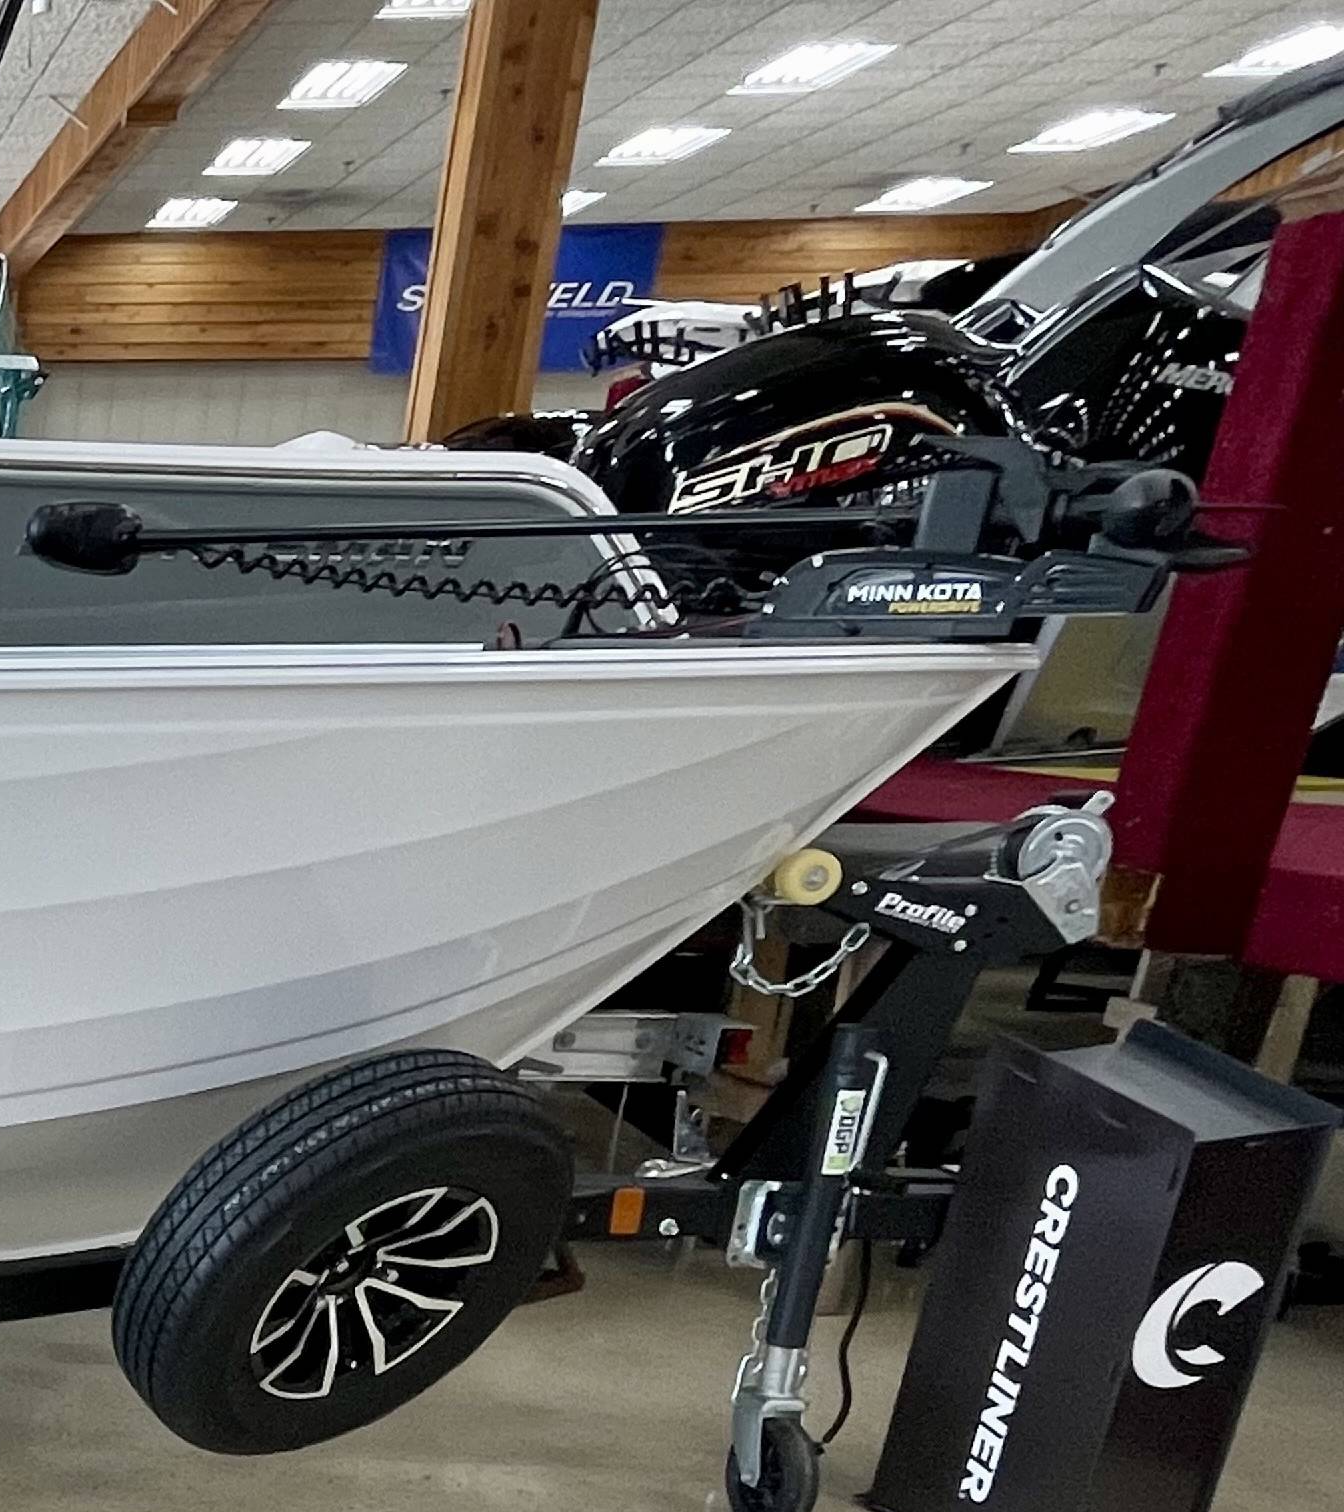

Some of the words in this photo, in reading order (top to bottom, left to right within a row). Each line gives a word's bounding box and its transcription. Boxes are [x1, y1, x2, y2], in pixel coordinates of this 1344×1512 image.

[847, 584, 913, 602] MINN
[916, 582, 982, 600] KOTA
[961, 1164, 1080, 1504] CRESTLINER
